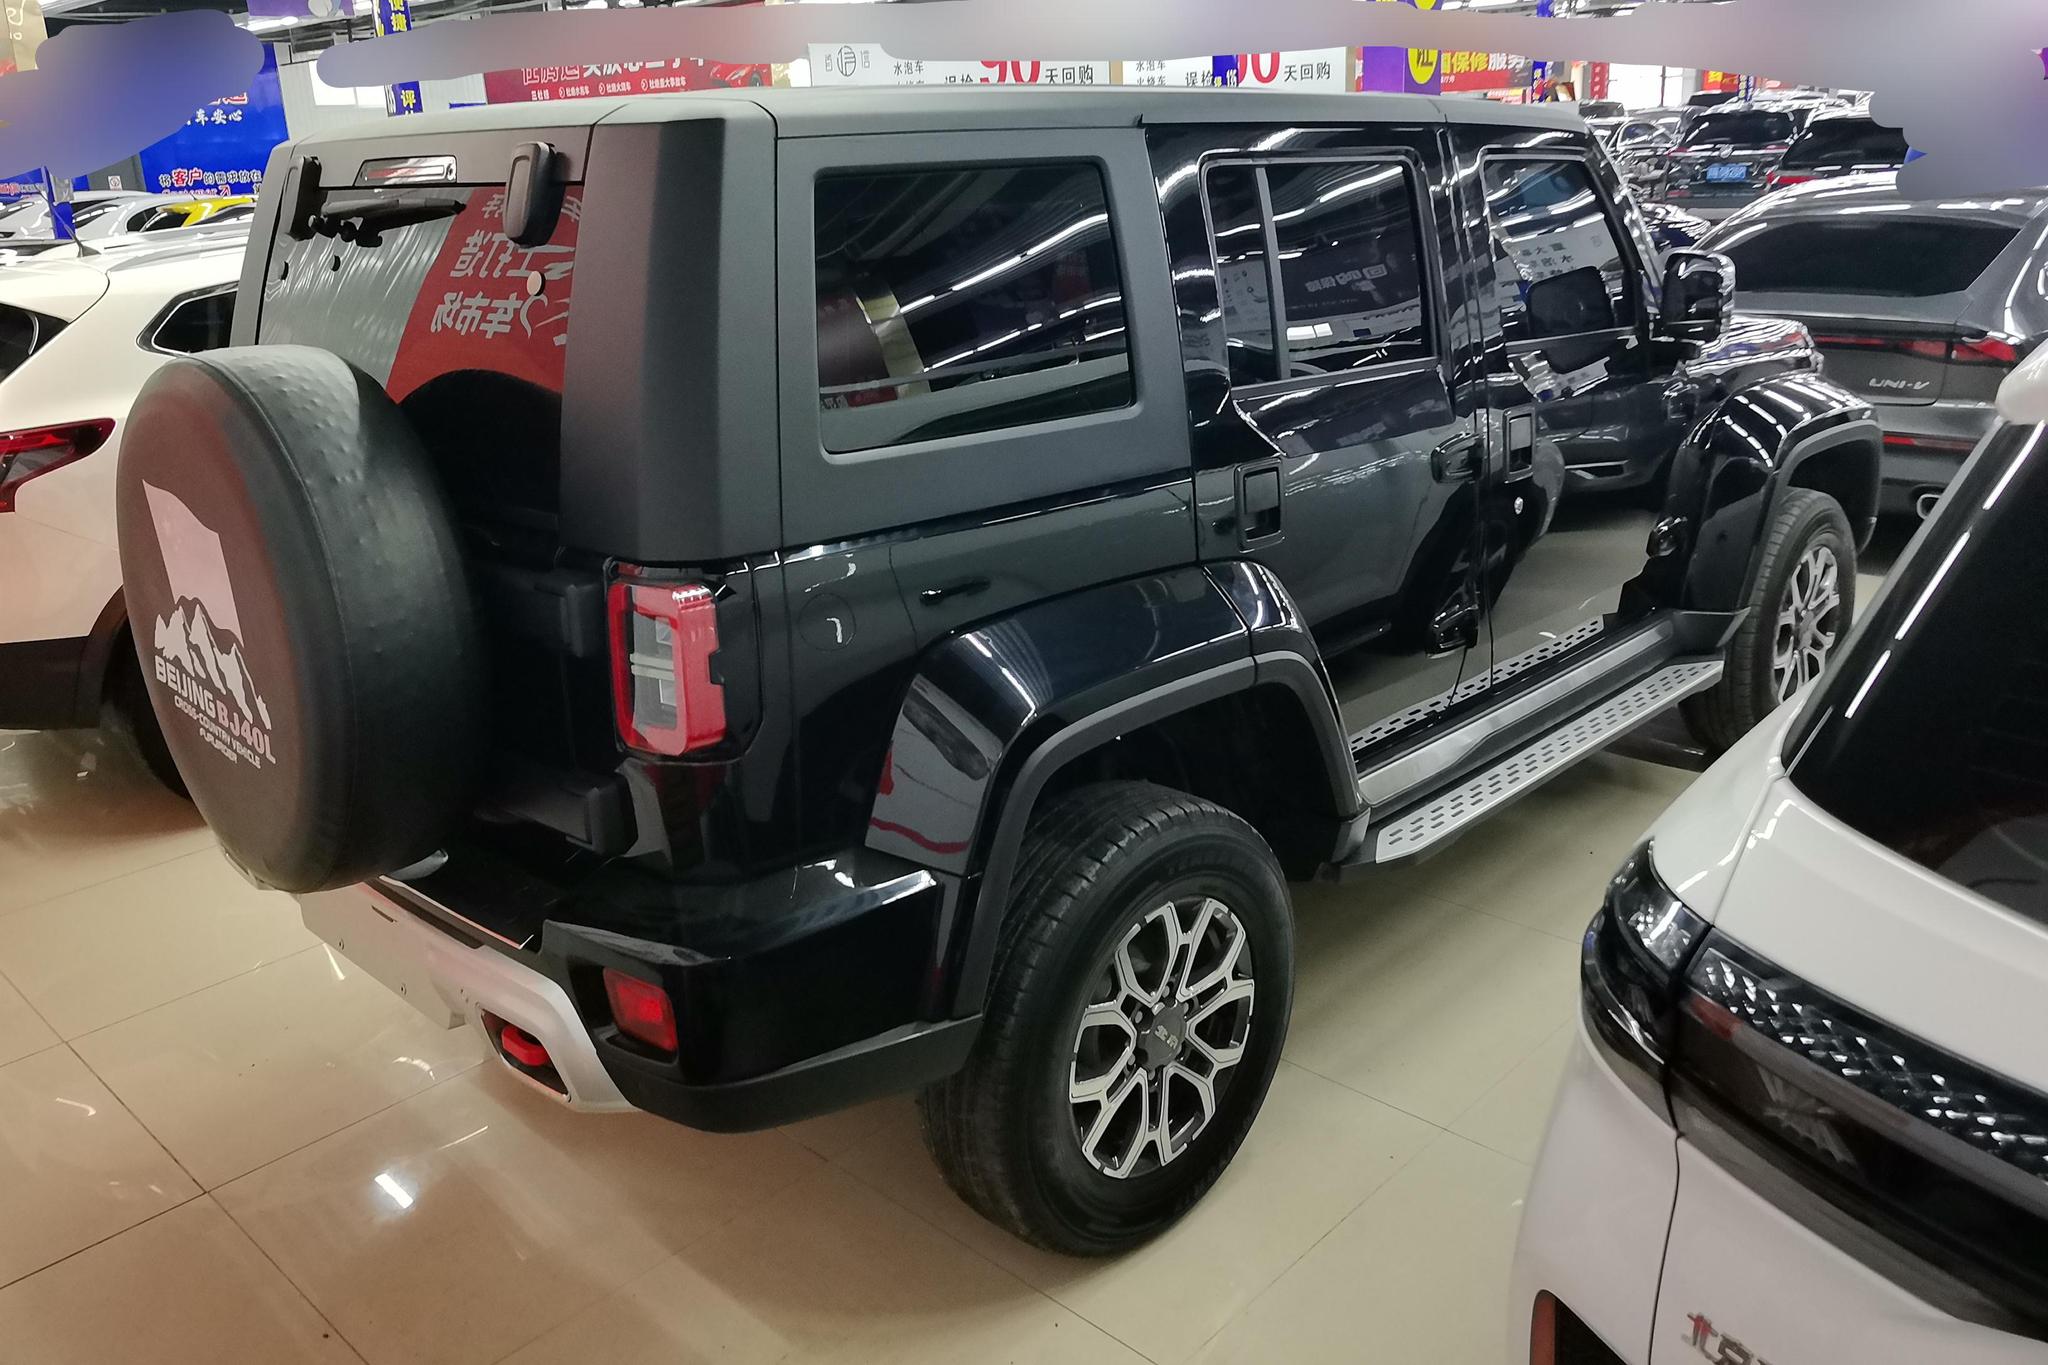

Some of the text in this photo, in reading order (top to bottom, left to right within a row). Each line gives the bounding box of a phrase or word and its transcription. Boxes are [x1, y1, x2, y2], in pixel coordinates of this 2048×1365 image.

[187, 108, 243, 126] 车安心
[1869, 378, 1930, 390] UNI-V
[155, 655, 216, 719] BEIJING
[216, 700, 276, 764] BJ40L
